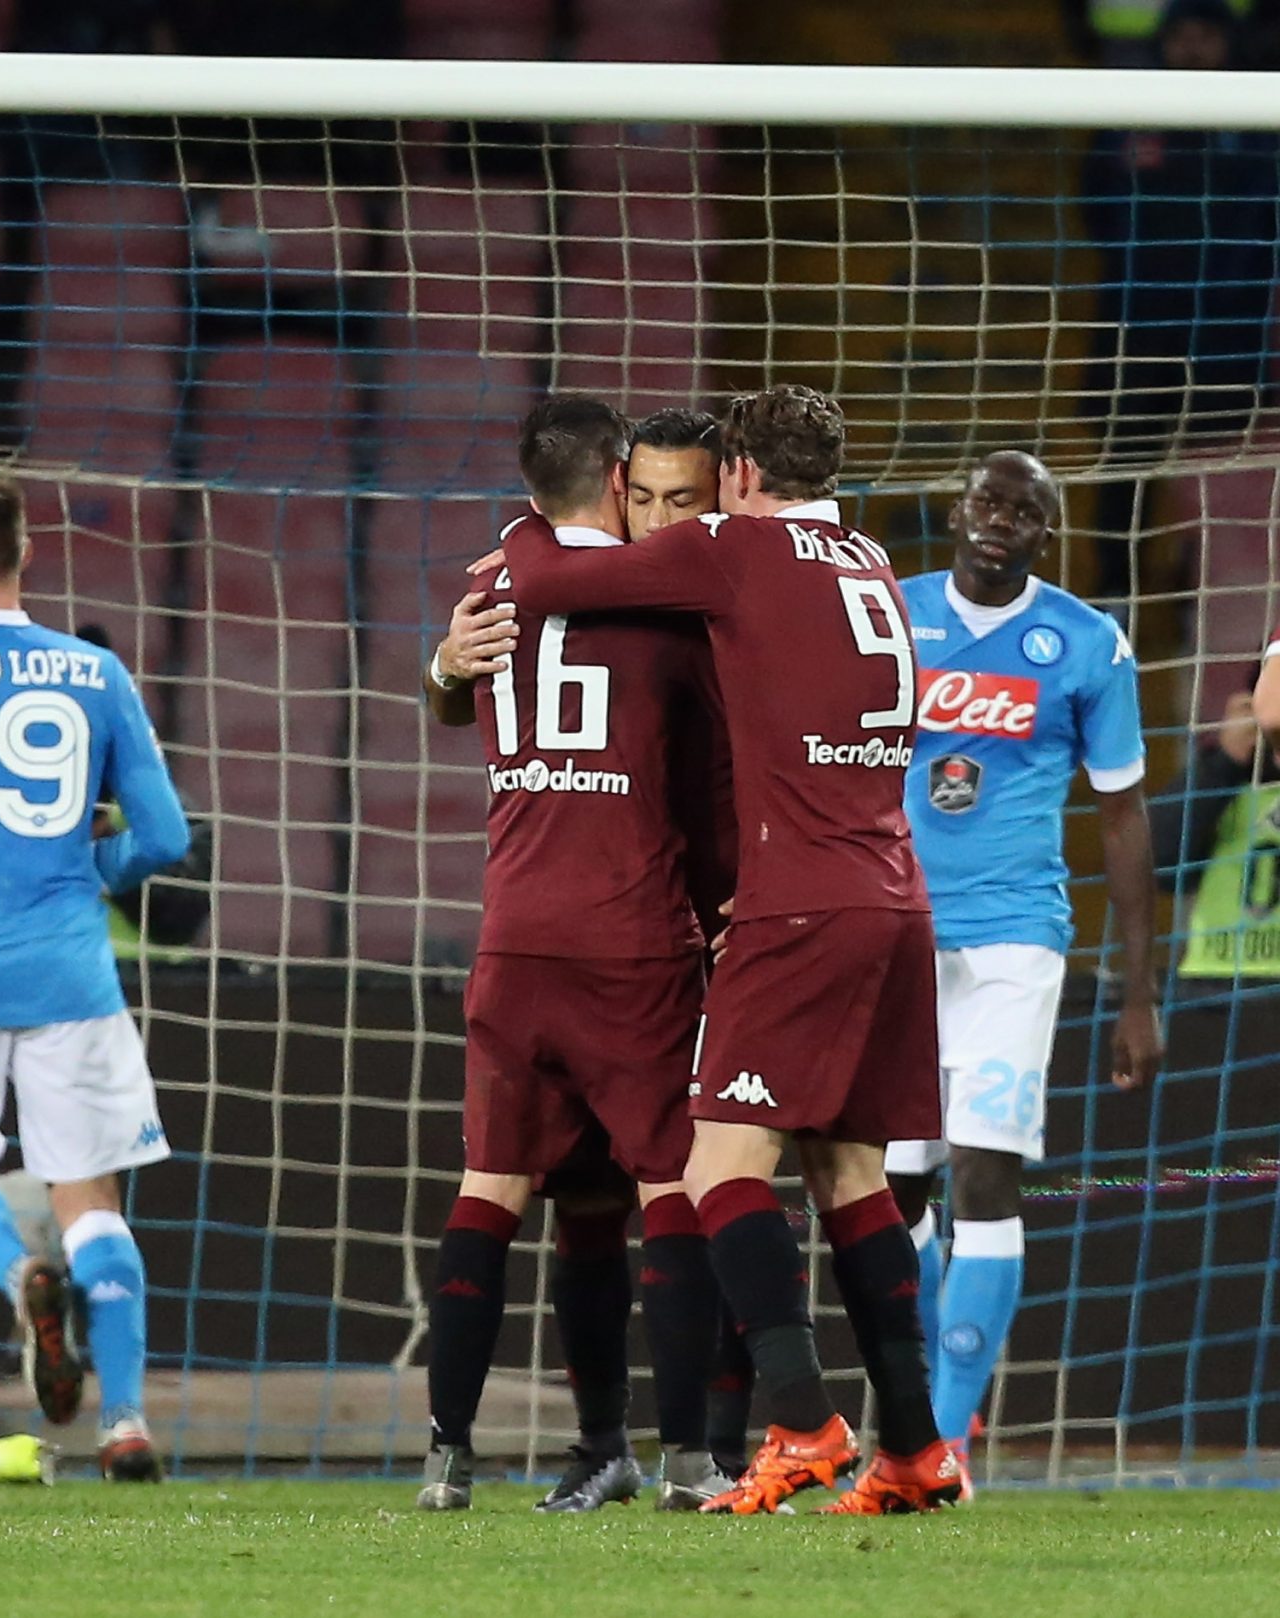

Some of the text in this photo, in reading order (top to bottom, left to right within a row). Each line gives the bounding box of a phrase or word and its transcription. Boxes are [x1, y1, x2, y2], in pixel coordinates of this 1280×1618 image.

[8, 649, 107, 691] LOPEZ
[492, 602, 610, 756] 16
[837, 576, 915, 729] 9
[917, 671, 1038, 734] Lete
[802, 734, 913, 768] Tecnoala
[968, 1059, 1042, 1128] 26
